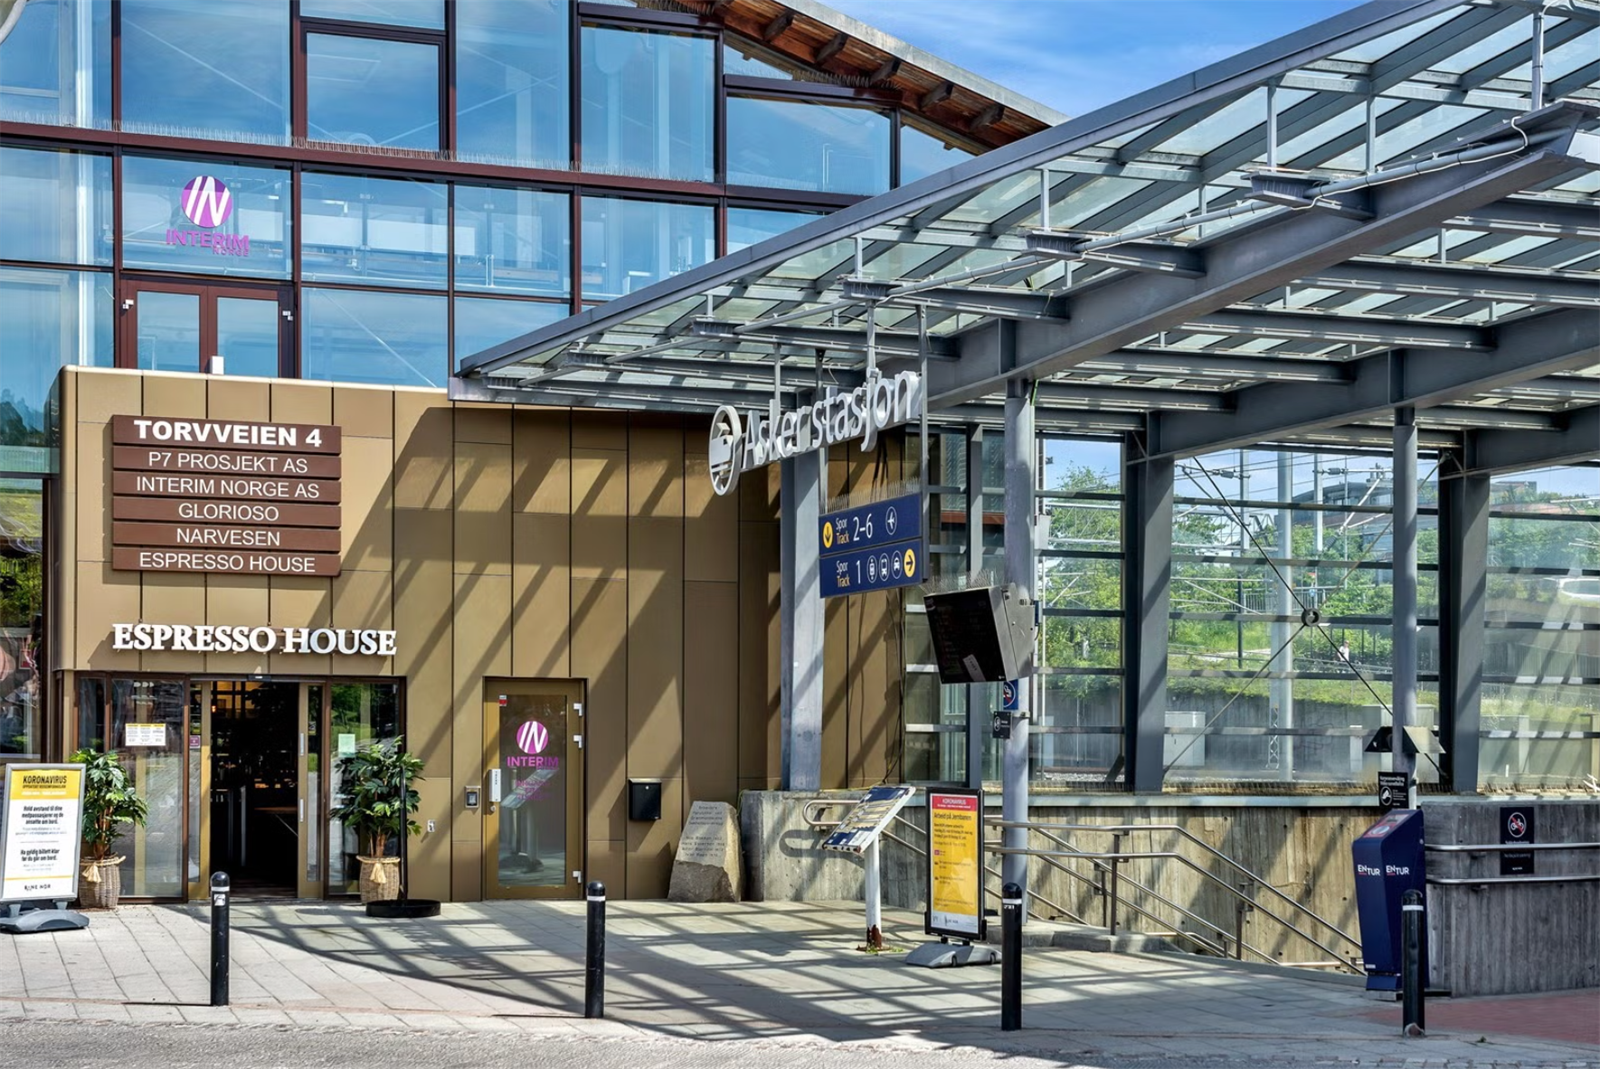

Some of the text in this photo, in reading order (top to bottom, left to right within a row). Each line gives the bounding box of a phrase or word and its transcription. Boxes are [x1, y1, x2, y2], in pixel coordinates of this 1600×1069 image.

[165, 230, 250, 250] INTERIM
[213, 247, 249, 257] NORGE
[743, 370, 922, 470] Asker stasjon
[134, 420, 322, 448] TORVVEIEN 4
[149, 452, 308, 474] P7 PROSJEKT AS
[136, 476, 319, 499] INTERIM NORGE AS
[178, 503, 280, 522] GLORIOSO
[836, 517, 847, 532] Spor
[177, 528, 280, 546] NARVESEN
[836, 531, 849, 544] Track
[139, 552, 316, 573] ESPRESSO HOUSE
[836, 560, 848, 574] Spor
[837, 574, 850, 587] Track
[856, 560, 861, 584] 1
[112, 623, 397, 655] ESPRESSO HOUSE
[507, 756, 558, 767] INTERIM
[23, 775, 67, 784] KORONAVIRUS
[1357, 864, 1380, 876] ENTUR
[1386, 864, 1410, 876] ENTUR
